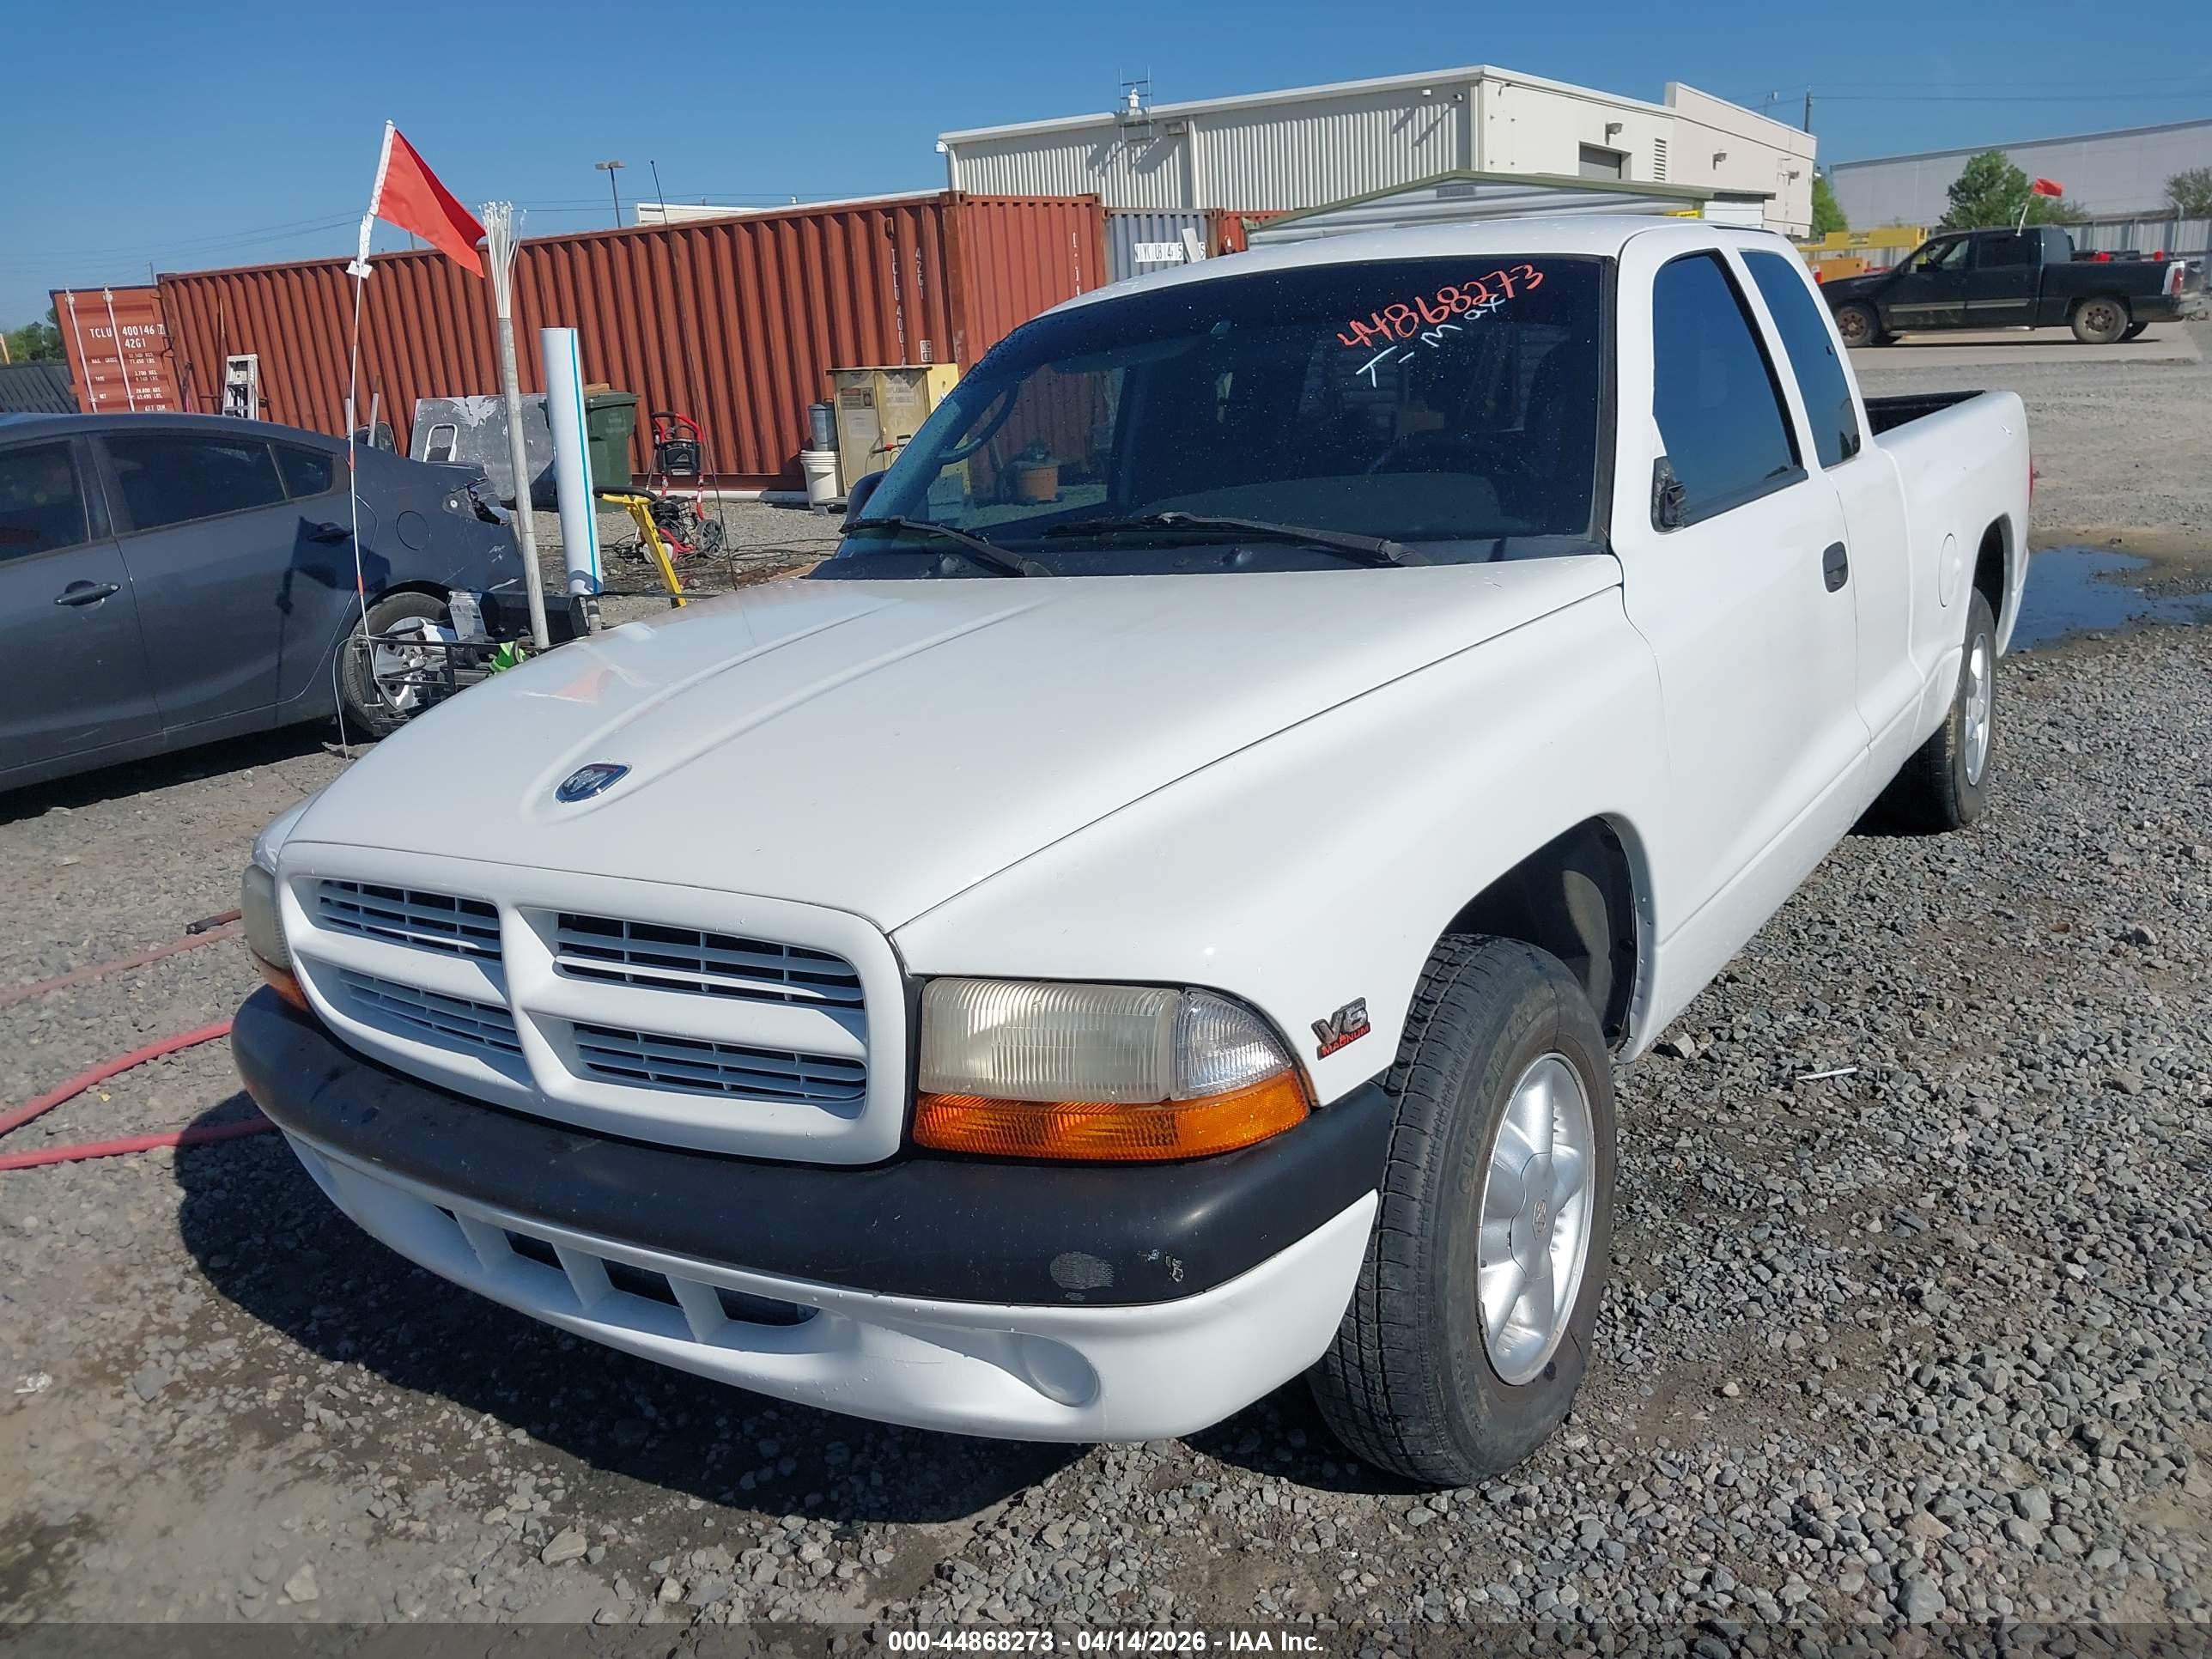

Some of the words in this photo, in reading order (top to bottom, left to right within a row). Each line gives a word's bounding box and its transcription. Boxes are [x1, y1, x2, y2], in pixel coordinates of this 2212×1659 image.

[1337, 264, 1544, 348] 44868273
[89, 328, 112, 338] TCLU
[122, 324, 155, 336] 400146
[125, 338, 146, 349] 42G1
[1311, 996, 1369, 1045] V6
[1321, 1024, 1370, 1057] MAGNUM
